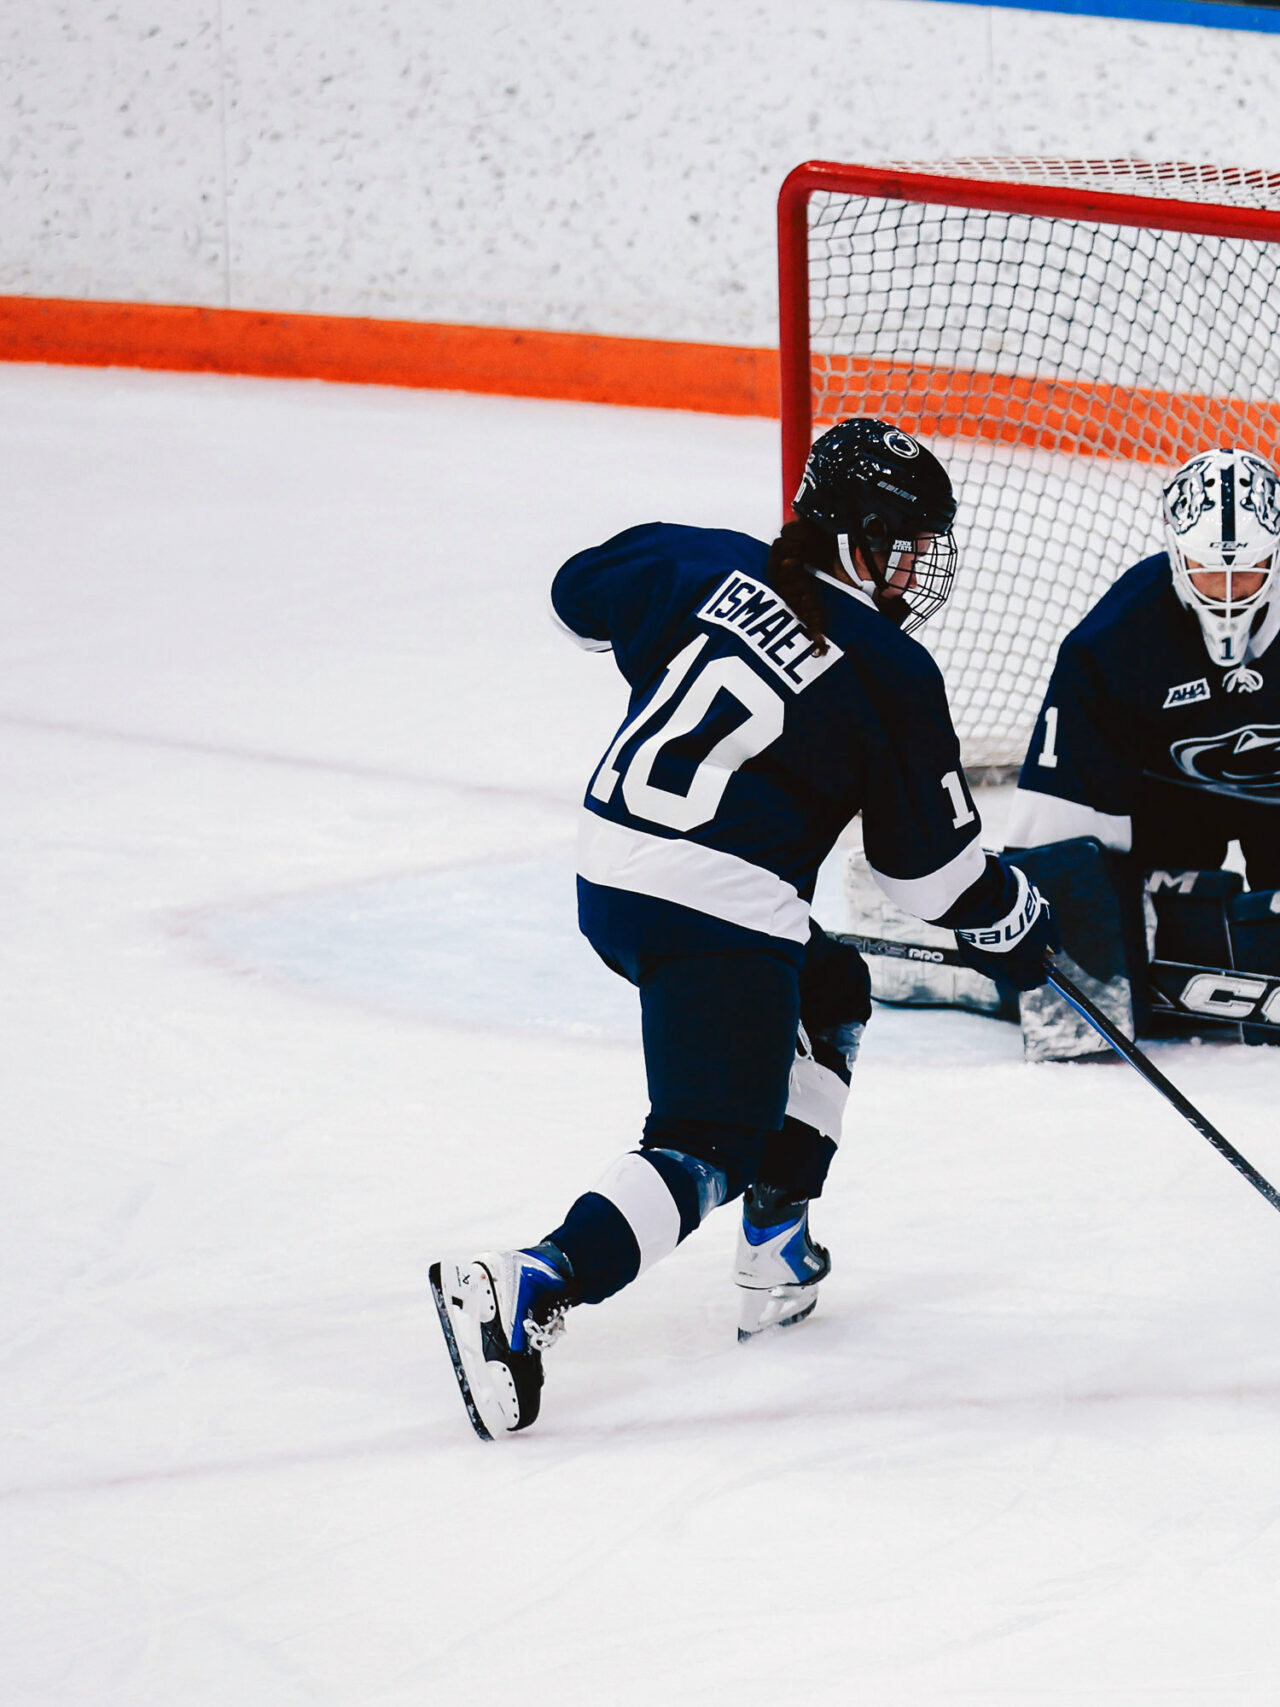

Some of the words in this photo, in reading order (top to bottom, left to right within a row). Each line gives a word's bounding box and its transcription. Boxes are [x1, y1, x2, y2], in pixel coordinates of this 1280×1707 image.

[894, 539, 912, 547] PENN
[1209, 541, 1249, 549] CCM
[706, 577, 814, 685] ISMAEL
[1221, 637, 1235, 660] 1
[1168, 682, 1207, 704] AHA
[590, 633, 785, 832] 10
[1037, 706, 1058, 768] 1
[941, 771, 975, 829] 1
[908, 948, 944, 963] PRO
